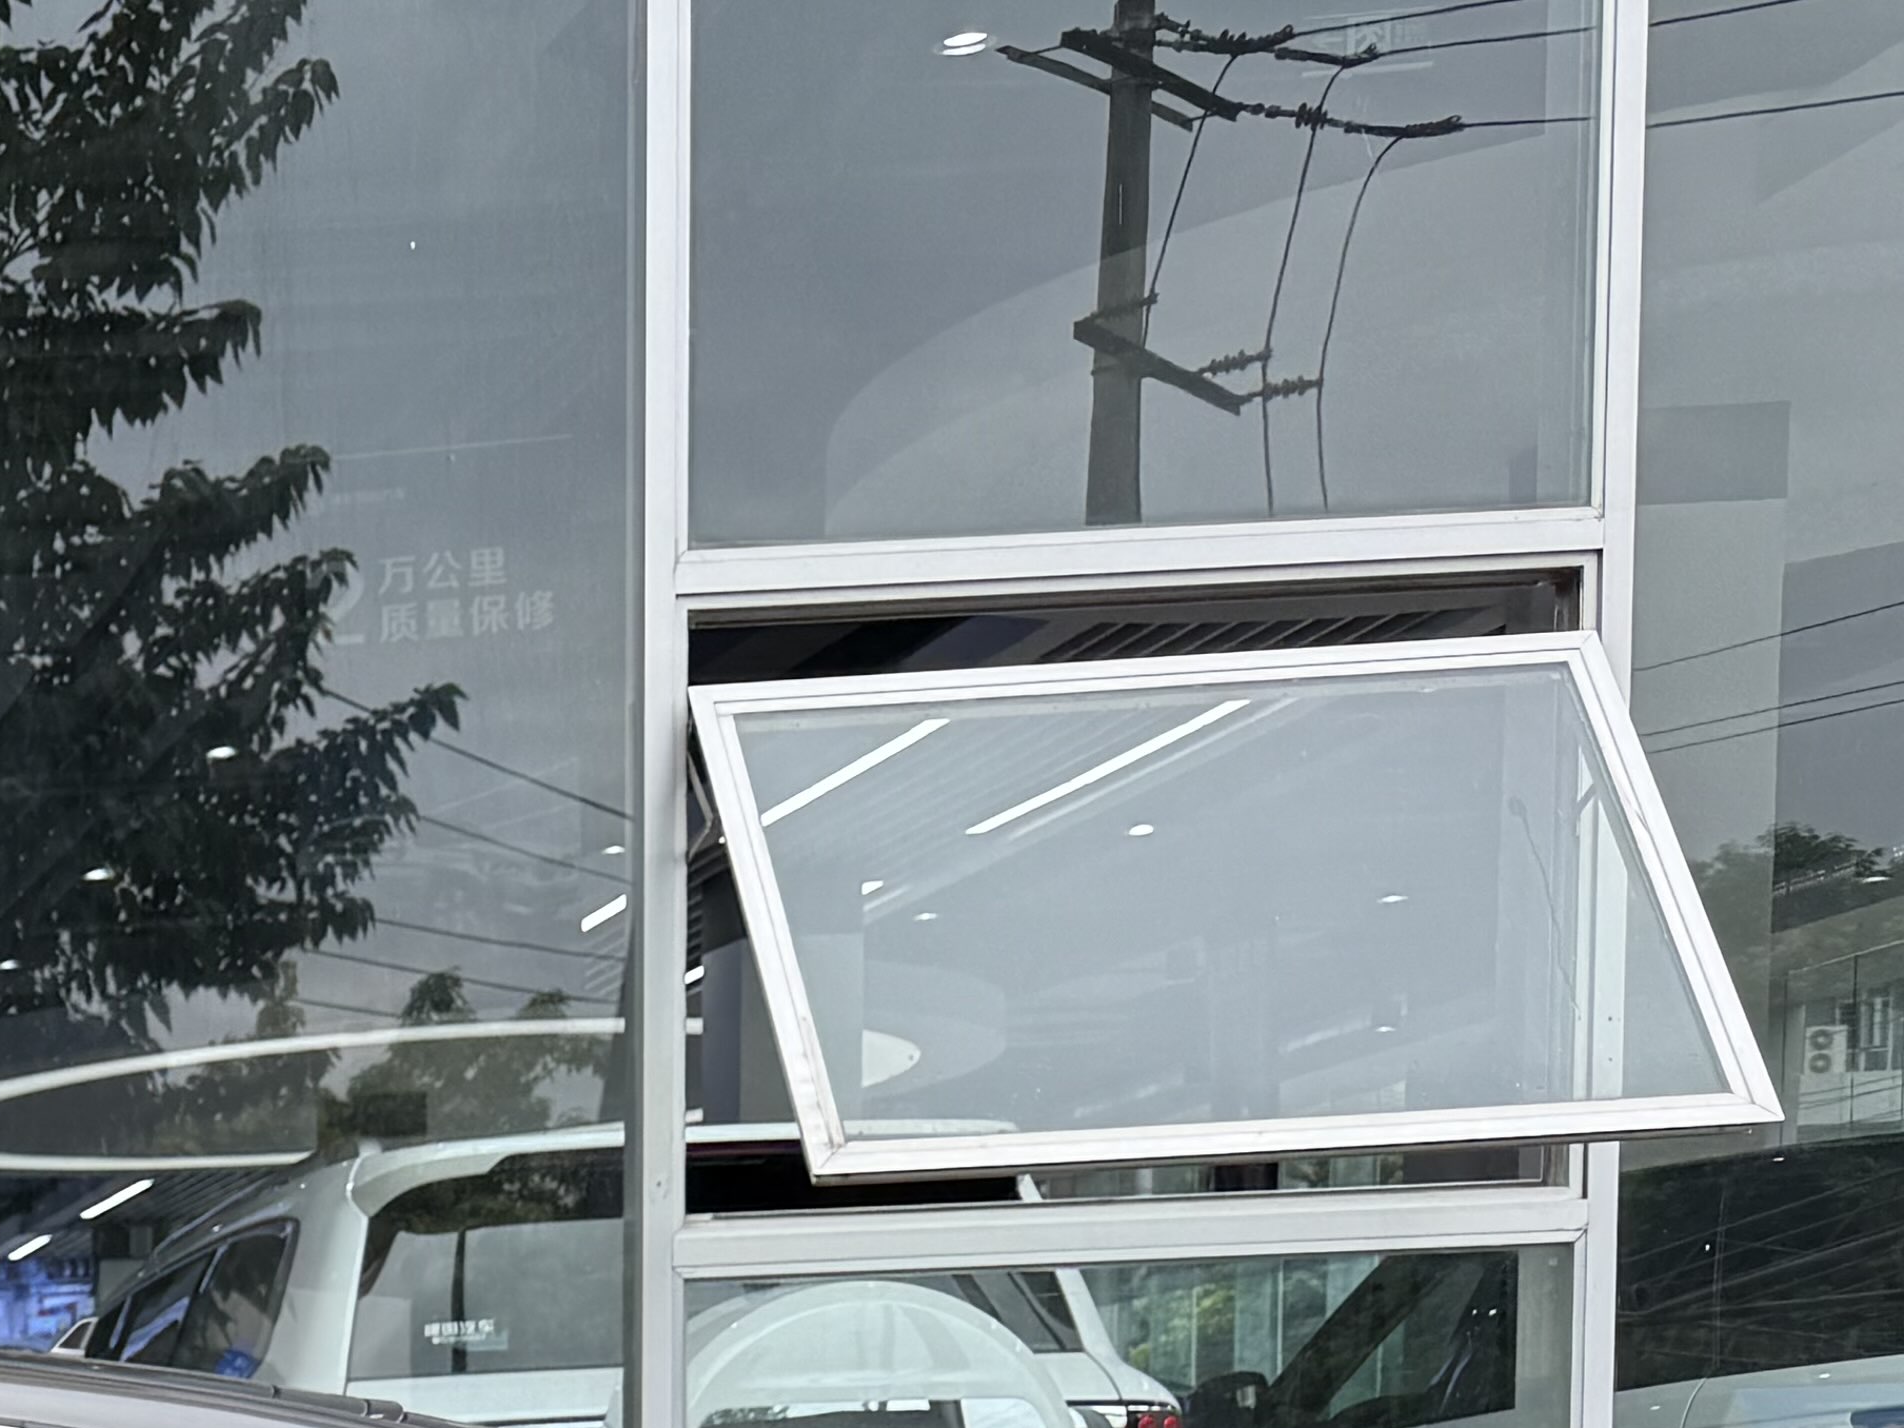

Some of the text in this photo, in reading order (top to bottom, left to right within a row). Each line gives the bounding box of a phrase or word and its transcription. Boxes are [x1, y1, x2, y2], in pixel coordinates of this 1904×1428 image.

[378, 547, 507, 596] 万公里
[379, 590, 554, 644] 质量保修
